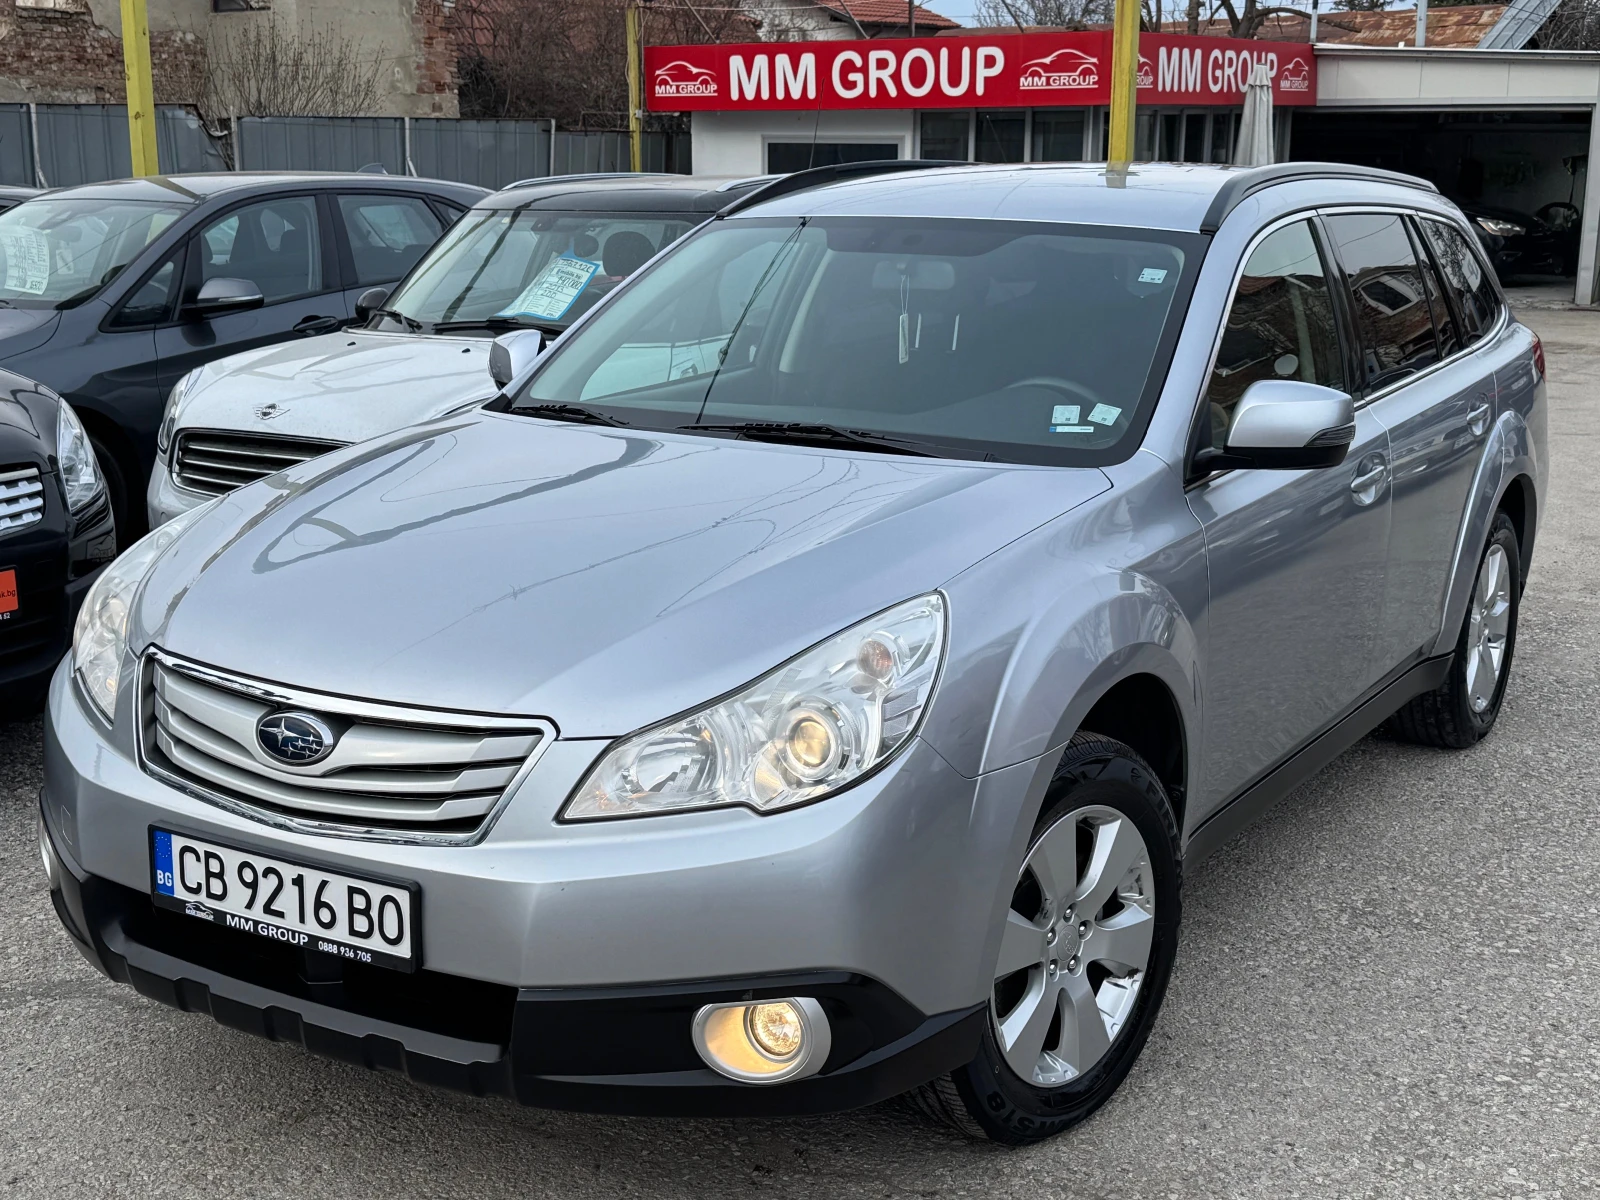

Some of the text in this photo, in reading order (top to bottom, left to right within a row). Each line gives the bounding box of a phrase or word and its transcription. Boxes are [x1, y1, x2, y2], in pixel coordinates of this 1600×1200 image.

[729, 46, 1005, 101] MM GROUP
[1158, 46, 1202, 93] MM
[655, 83, 718, 94] MM GROUP
[1020, 75, 1099, 87] MM GROUP
[1137, 75, 1154, 85] ROUP
[1291, 80, 1309, 89] GROUP
[156, 869, 173, 887] BG
[179, 844, 404, 946] CB 9216 BO
[226, 913, 254, 932] MM
[257, 923, 309, 946] GROUP
[318, 940, 338, 954] 0888
[339, 946, 355, 958] 936
[356, 950, 372, 962] 705
